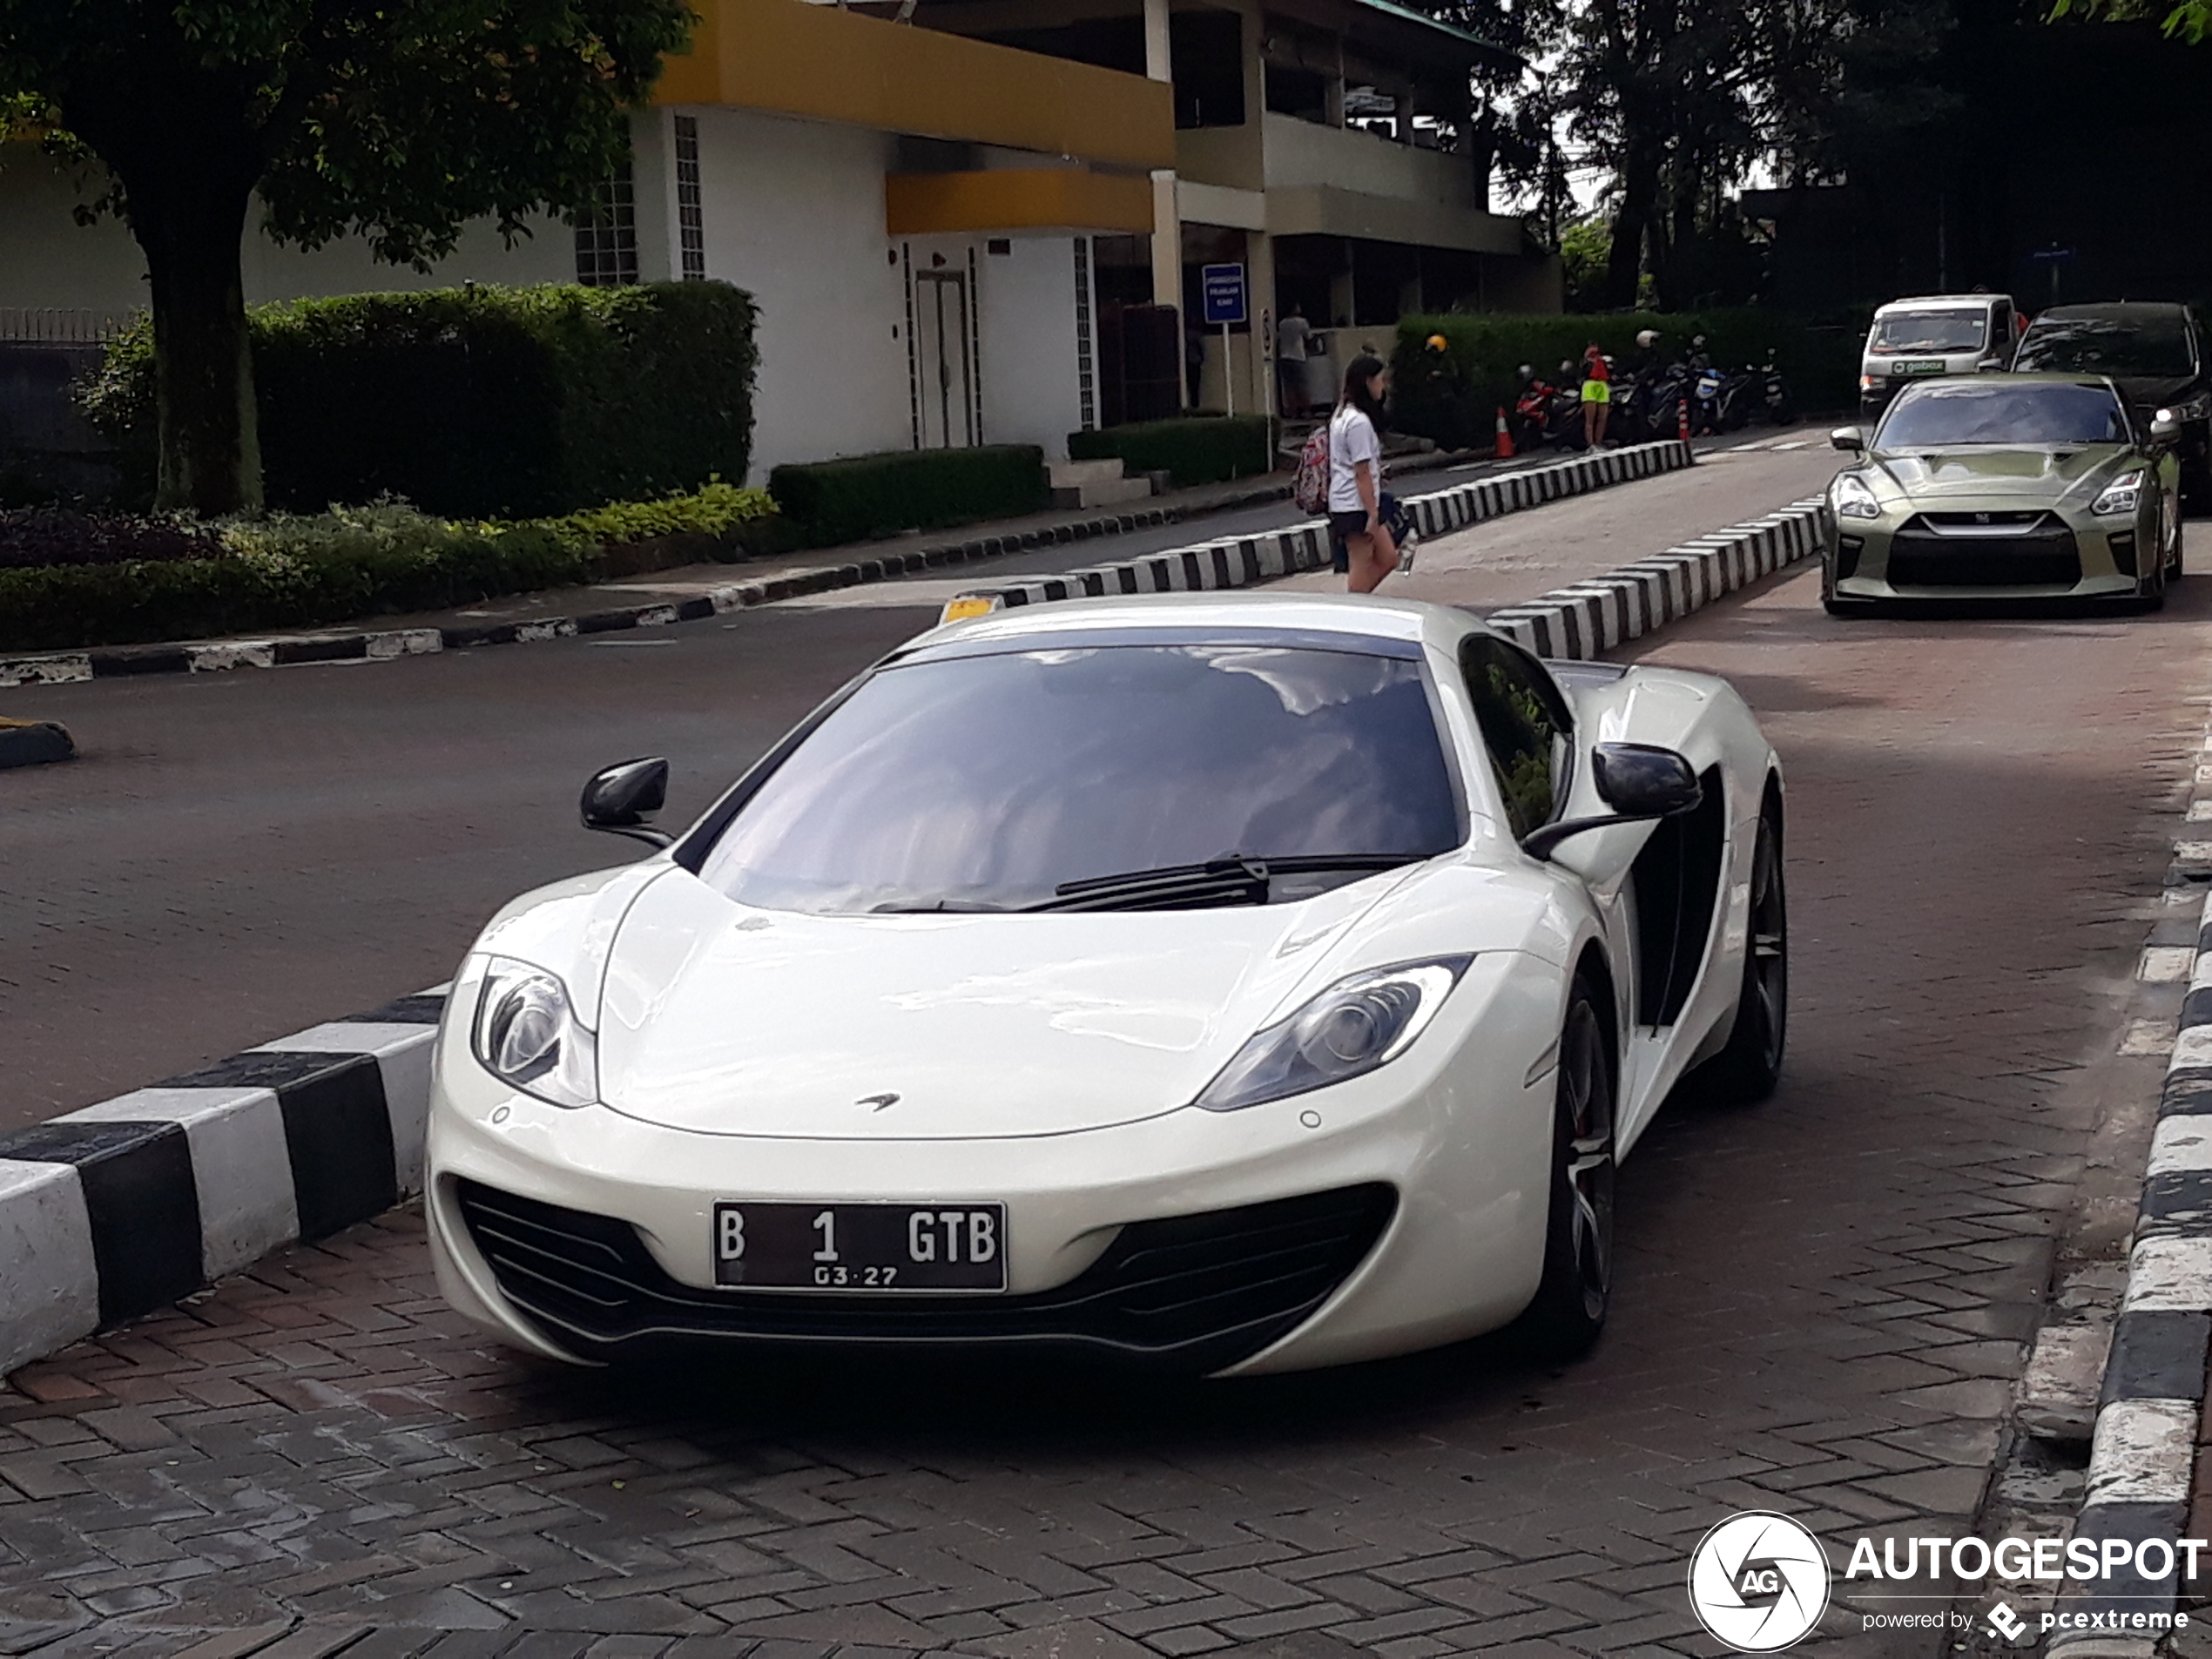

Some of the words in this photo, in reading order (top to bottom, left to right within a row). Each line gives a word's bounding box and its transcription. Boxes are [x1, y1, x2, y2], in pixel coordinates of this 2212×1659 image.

[720, 1210, 745, 1260] B
[813, 1211, 839, 1262] 1
[908, 1211, 996, 1263] GTB
